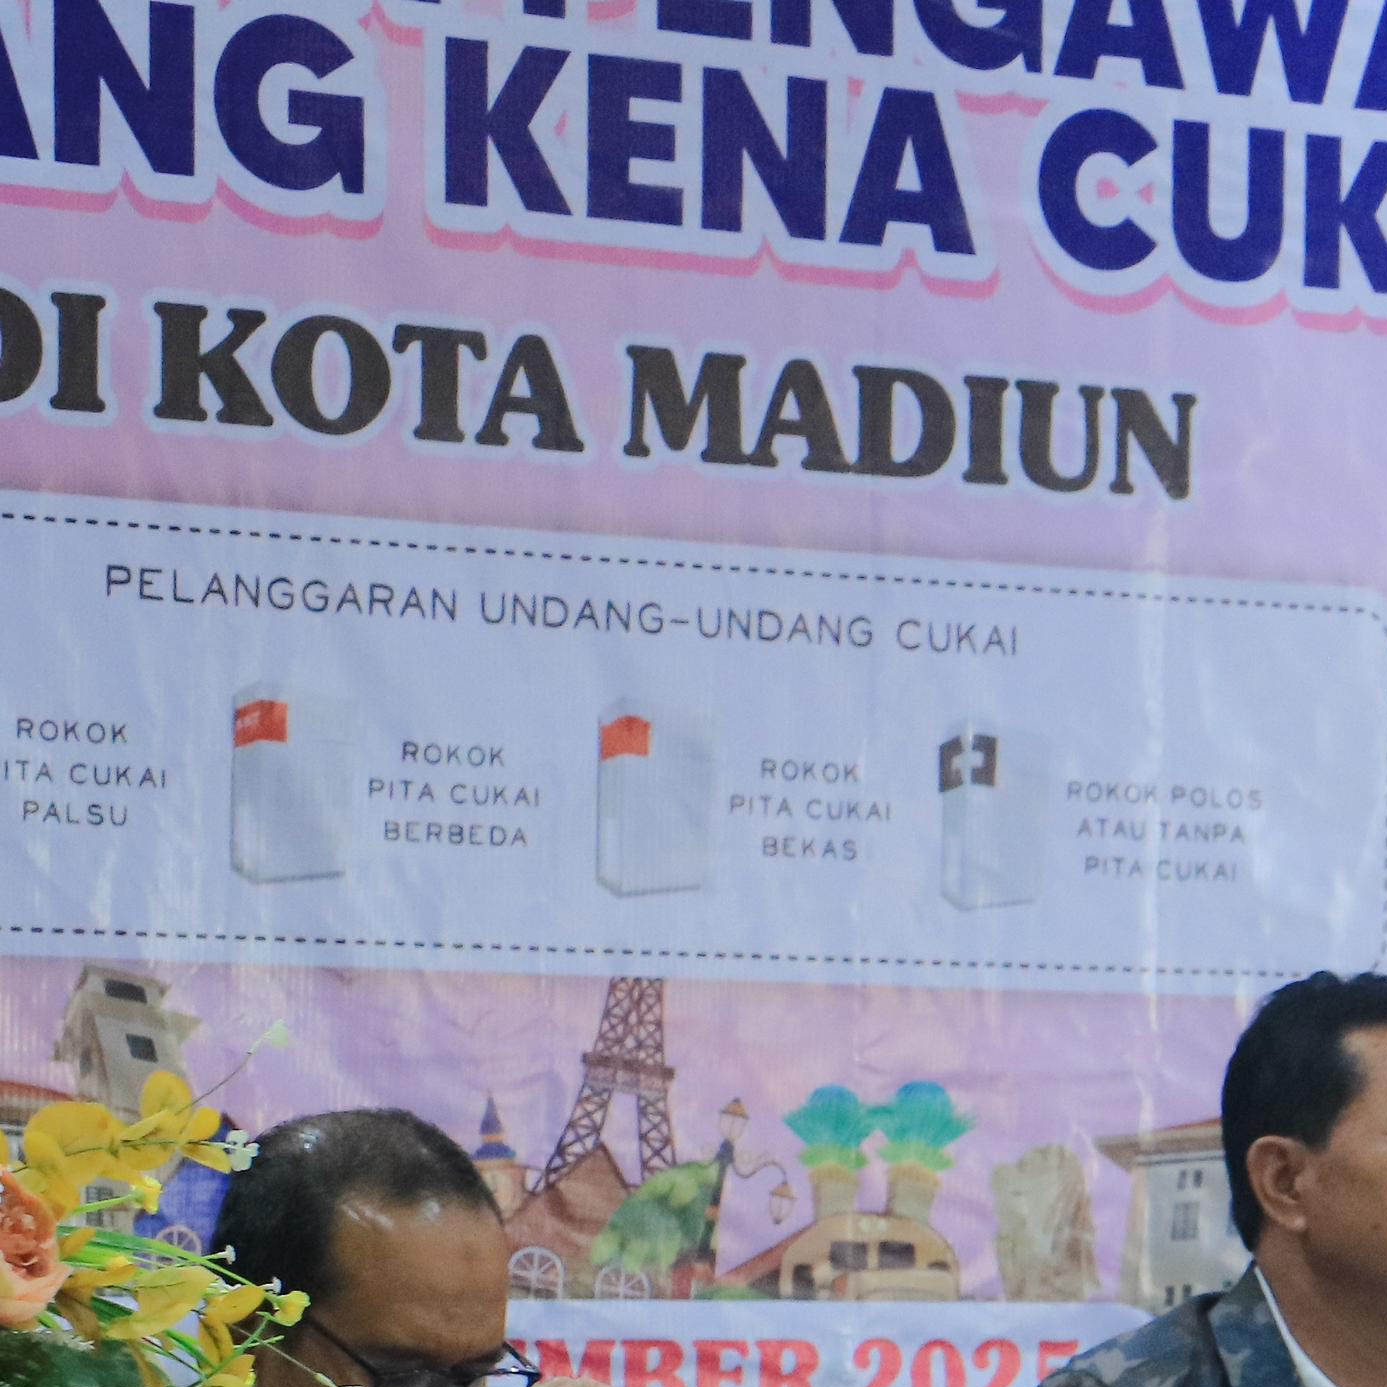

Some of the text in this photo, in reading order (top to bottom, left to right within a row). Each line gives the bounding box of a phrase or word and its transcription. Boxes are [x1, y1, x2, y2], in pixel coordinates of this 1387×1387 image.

[0, 0, 366, 195] NG
[444, 37, 977, 256] KENA
[152, 301, 585, 453] KOTA
[623, 344, 1197, 500] MADIUN
[104, 563, 1019, 656] PELANGGARAN UNDANG-UNDANG CUKAI
[16, 717, 128, 744] ROKOK
[401, 740, 505, 768] ROKOK
[3, 759, 167, 789] ITA CUKAI
[760, 758, 859, 784] ROKOK
[368, 777, 540, 808] PITA CUKAI
[1066, 781, 1263, 811] ROKOK POLOS
[22, 800, 128, 827] PALSU
[728, 794, 892, 822] PITA CUKAI
[384, 821, 529, 847] BERBEDA
[1077, 817, 1246, 844] ATAU TANPA
[762, 836, 858, 862] BEKAS
[1084, 854, 1238, 882] PITA CUKAI
